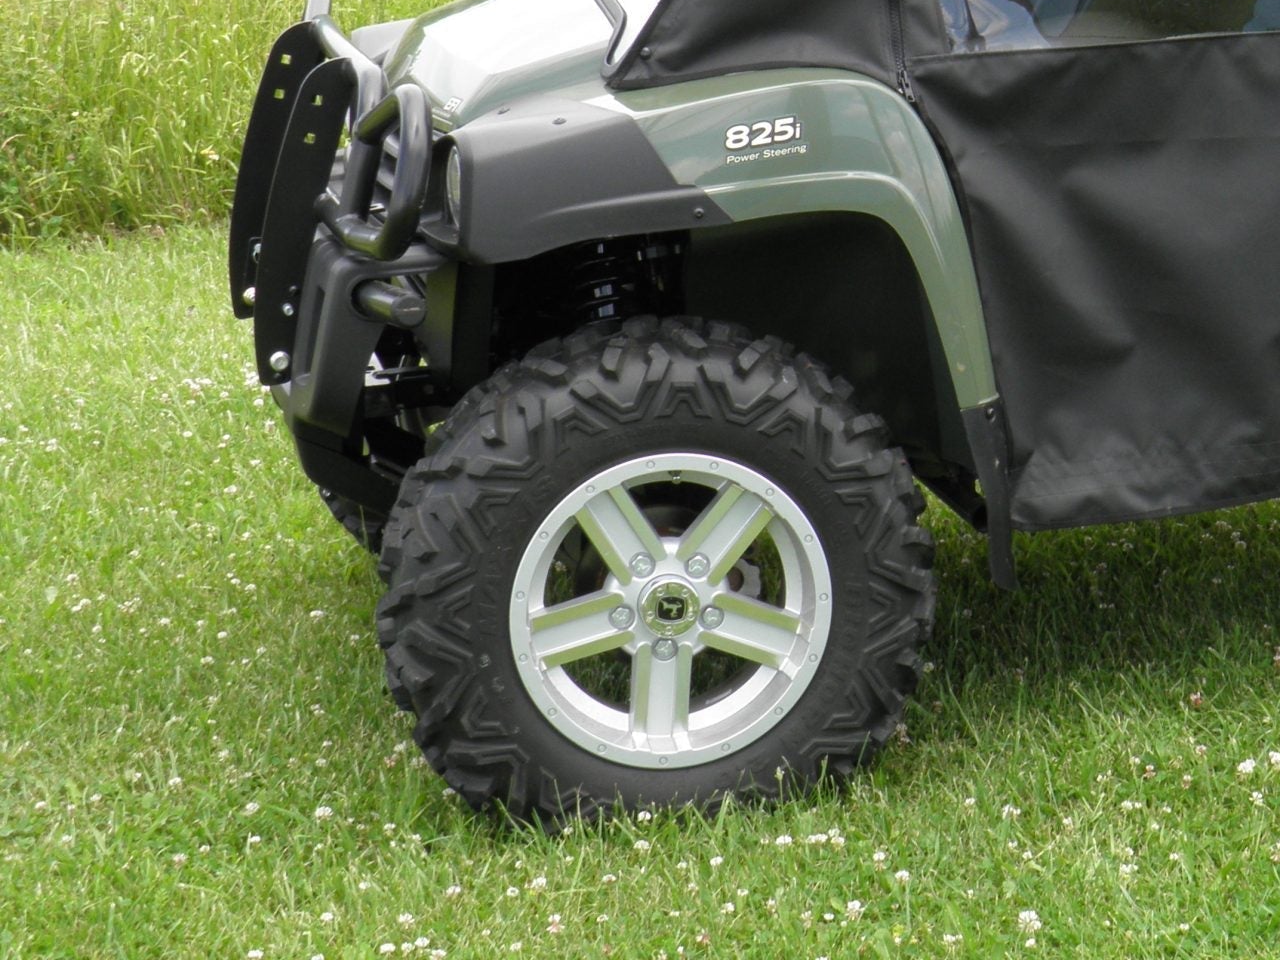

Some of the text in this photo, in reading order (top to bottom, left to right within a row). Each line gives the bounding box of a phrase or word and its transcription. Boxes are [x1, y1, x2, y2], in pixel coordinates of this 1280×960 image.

[725, 116, 801, 150] 825i
[726, 144, 807, 165] Power Steering
